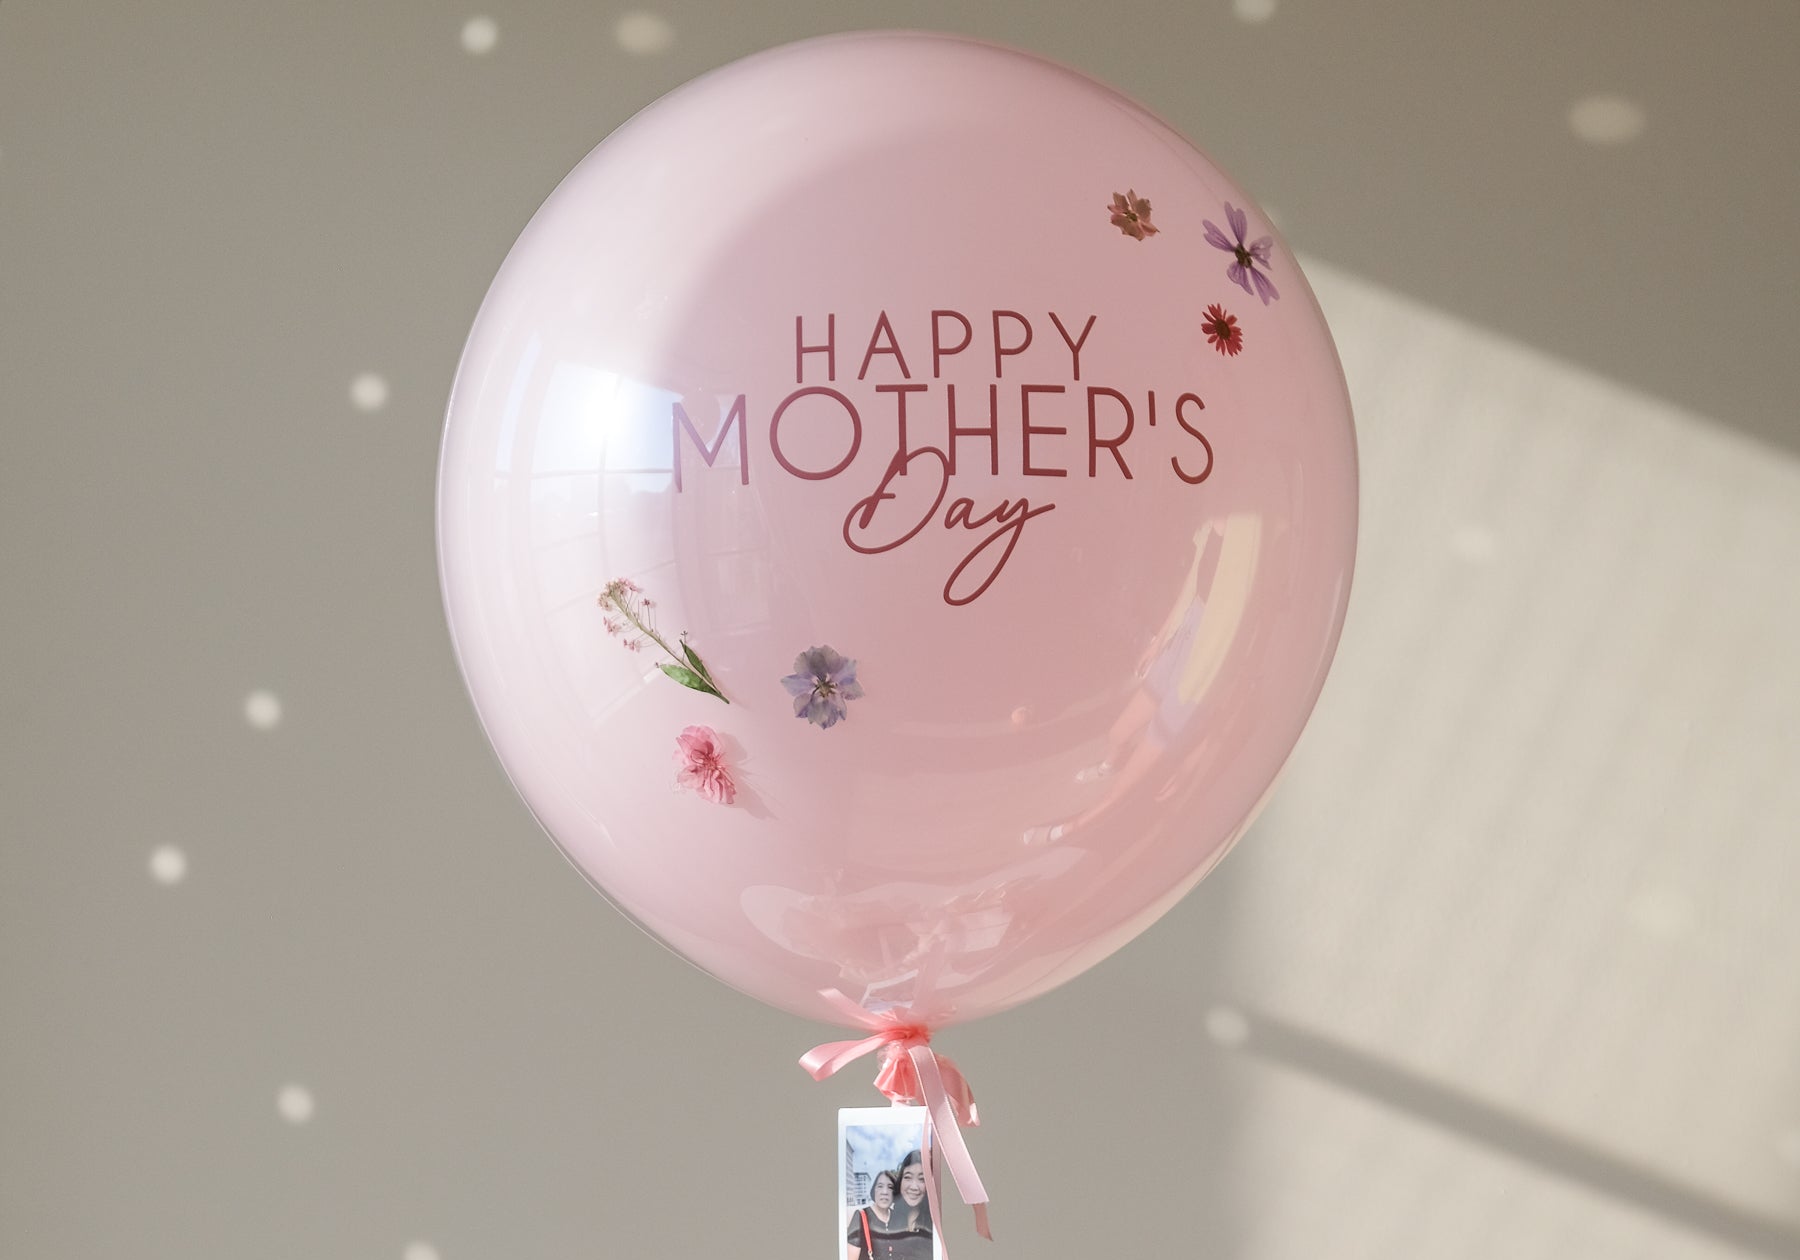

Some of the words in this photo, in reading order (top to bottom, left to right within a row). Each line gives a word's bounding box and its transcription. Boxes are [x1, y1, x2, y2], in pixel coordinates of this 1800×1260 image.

[796, 310, 1096, 383] HAPPY
[671, 384, 1214, 492] MOTHER'S
[843, 446, 1056, 606] Day
